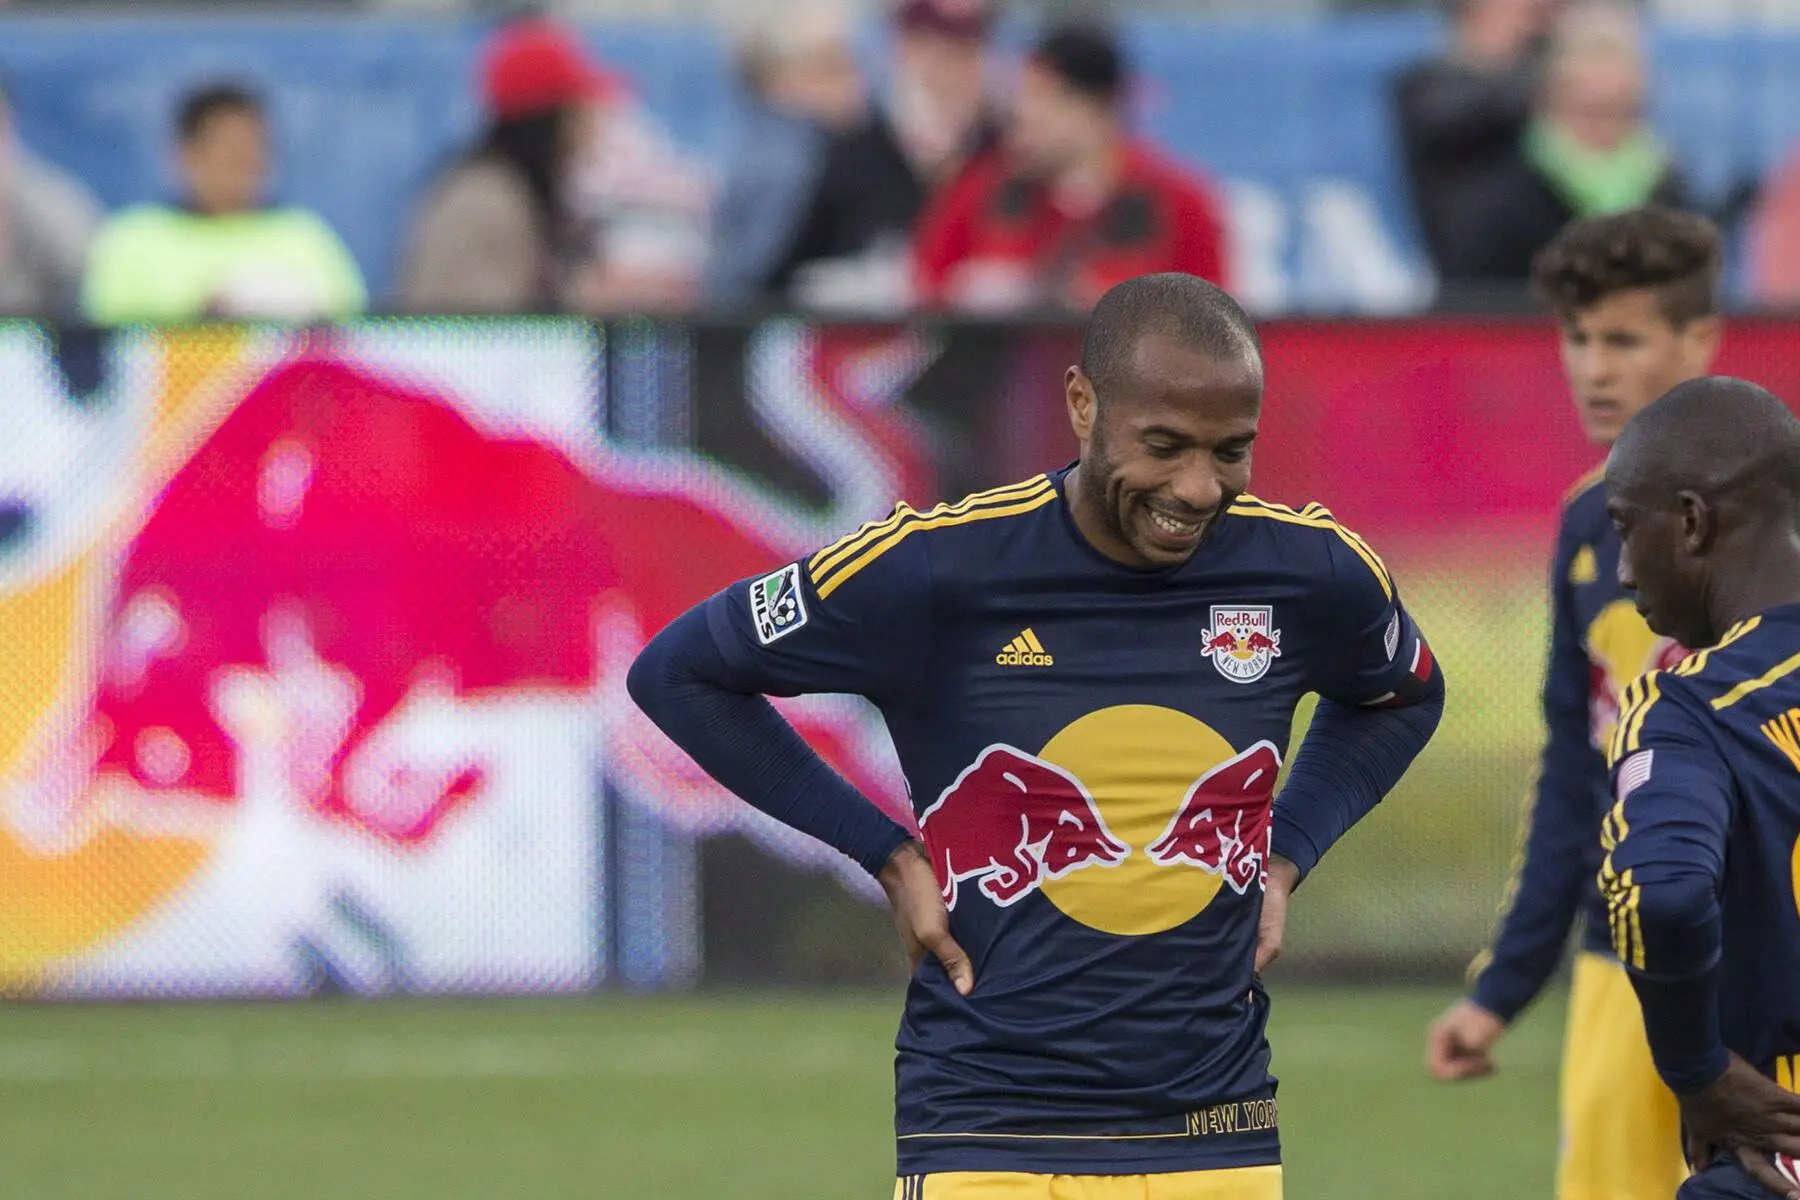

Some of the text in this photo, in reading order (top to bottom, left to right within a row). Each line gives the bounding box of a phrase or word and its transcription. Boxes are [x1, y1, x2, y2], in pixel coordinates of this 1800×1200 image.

[754, 582, 774, 640] MLS
[1216, 612, 1266, 627] Red Bull
[996, 651, 1054, 666] adidas
[1242, 1098, 1277, 1131] YOR
